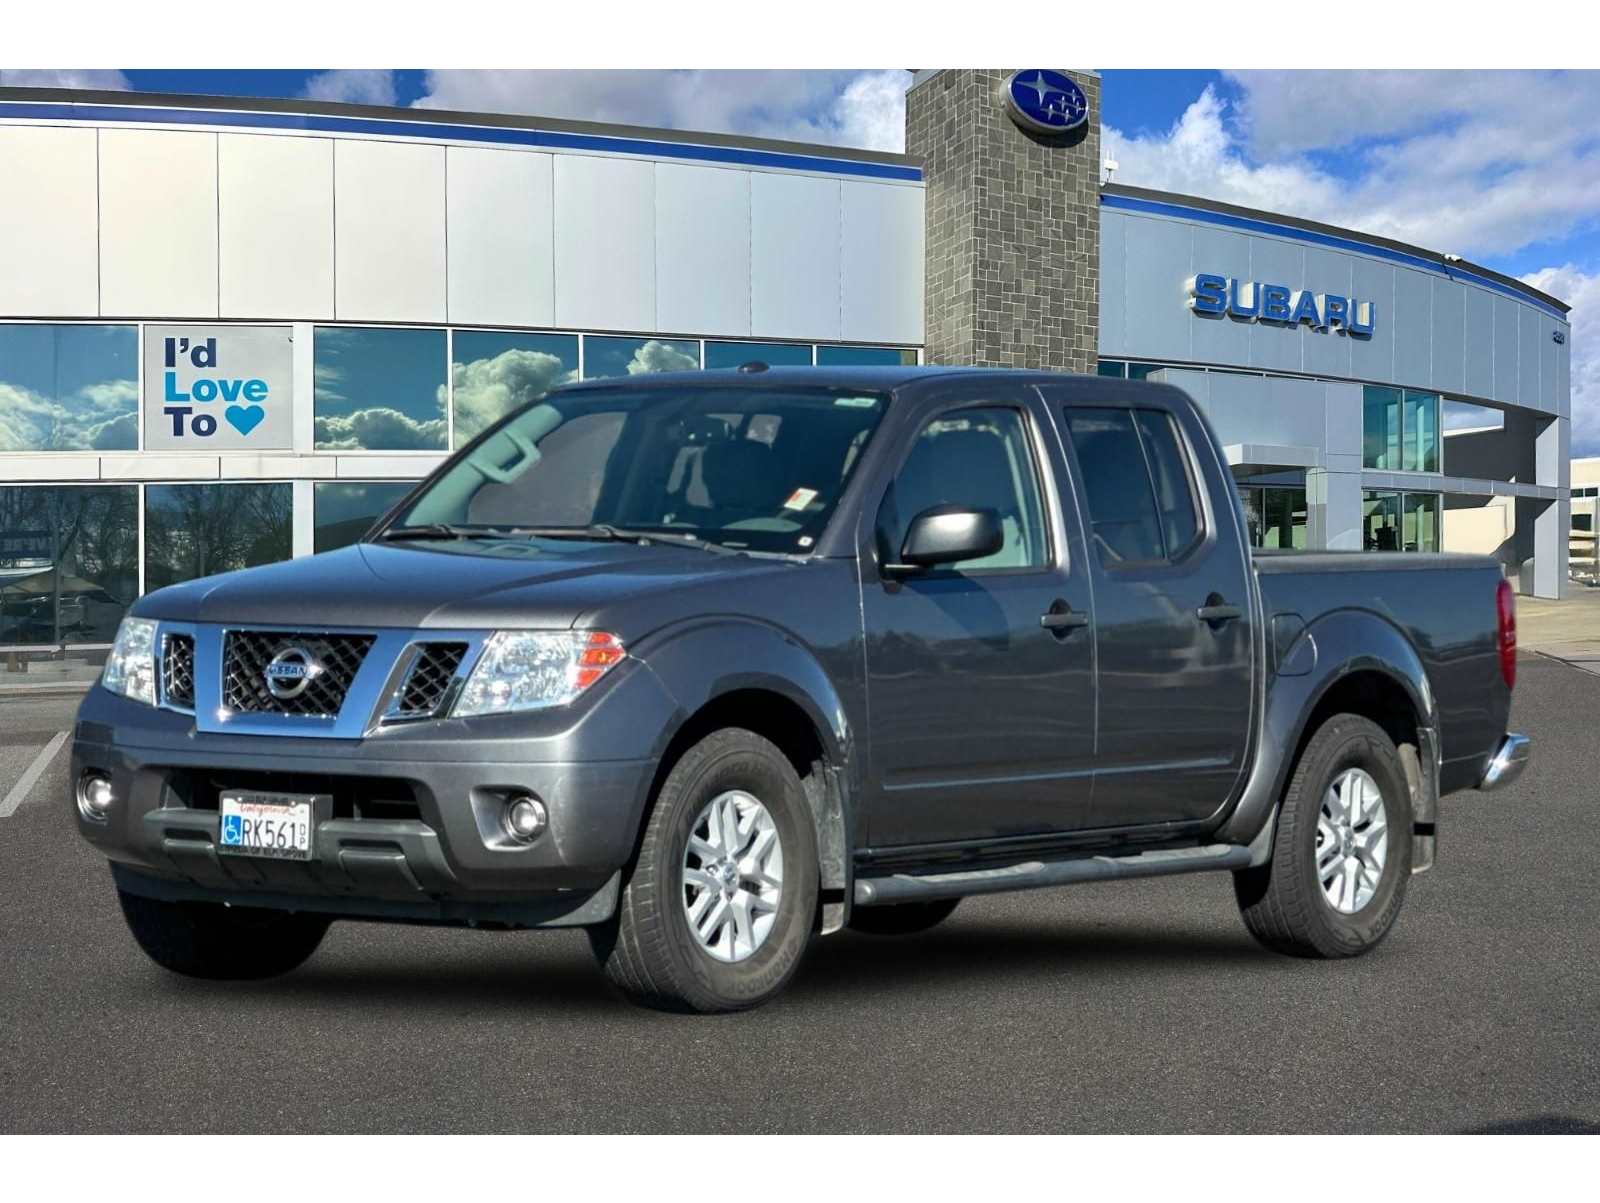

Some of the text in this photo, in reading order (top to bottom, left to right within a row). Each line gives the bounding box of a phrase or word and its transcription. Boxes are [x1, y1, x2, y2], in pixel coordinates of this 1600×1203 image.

[1194, 273, 1376, 338] SUBARU
[165, 337, 217, 368] I’d
[165, 371, 269, 402] Love
[164, 406, 217, 437] To
[243, 818, 296, 848] RK561
